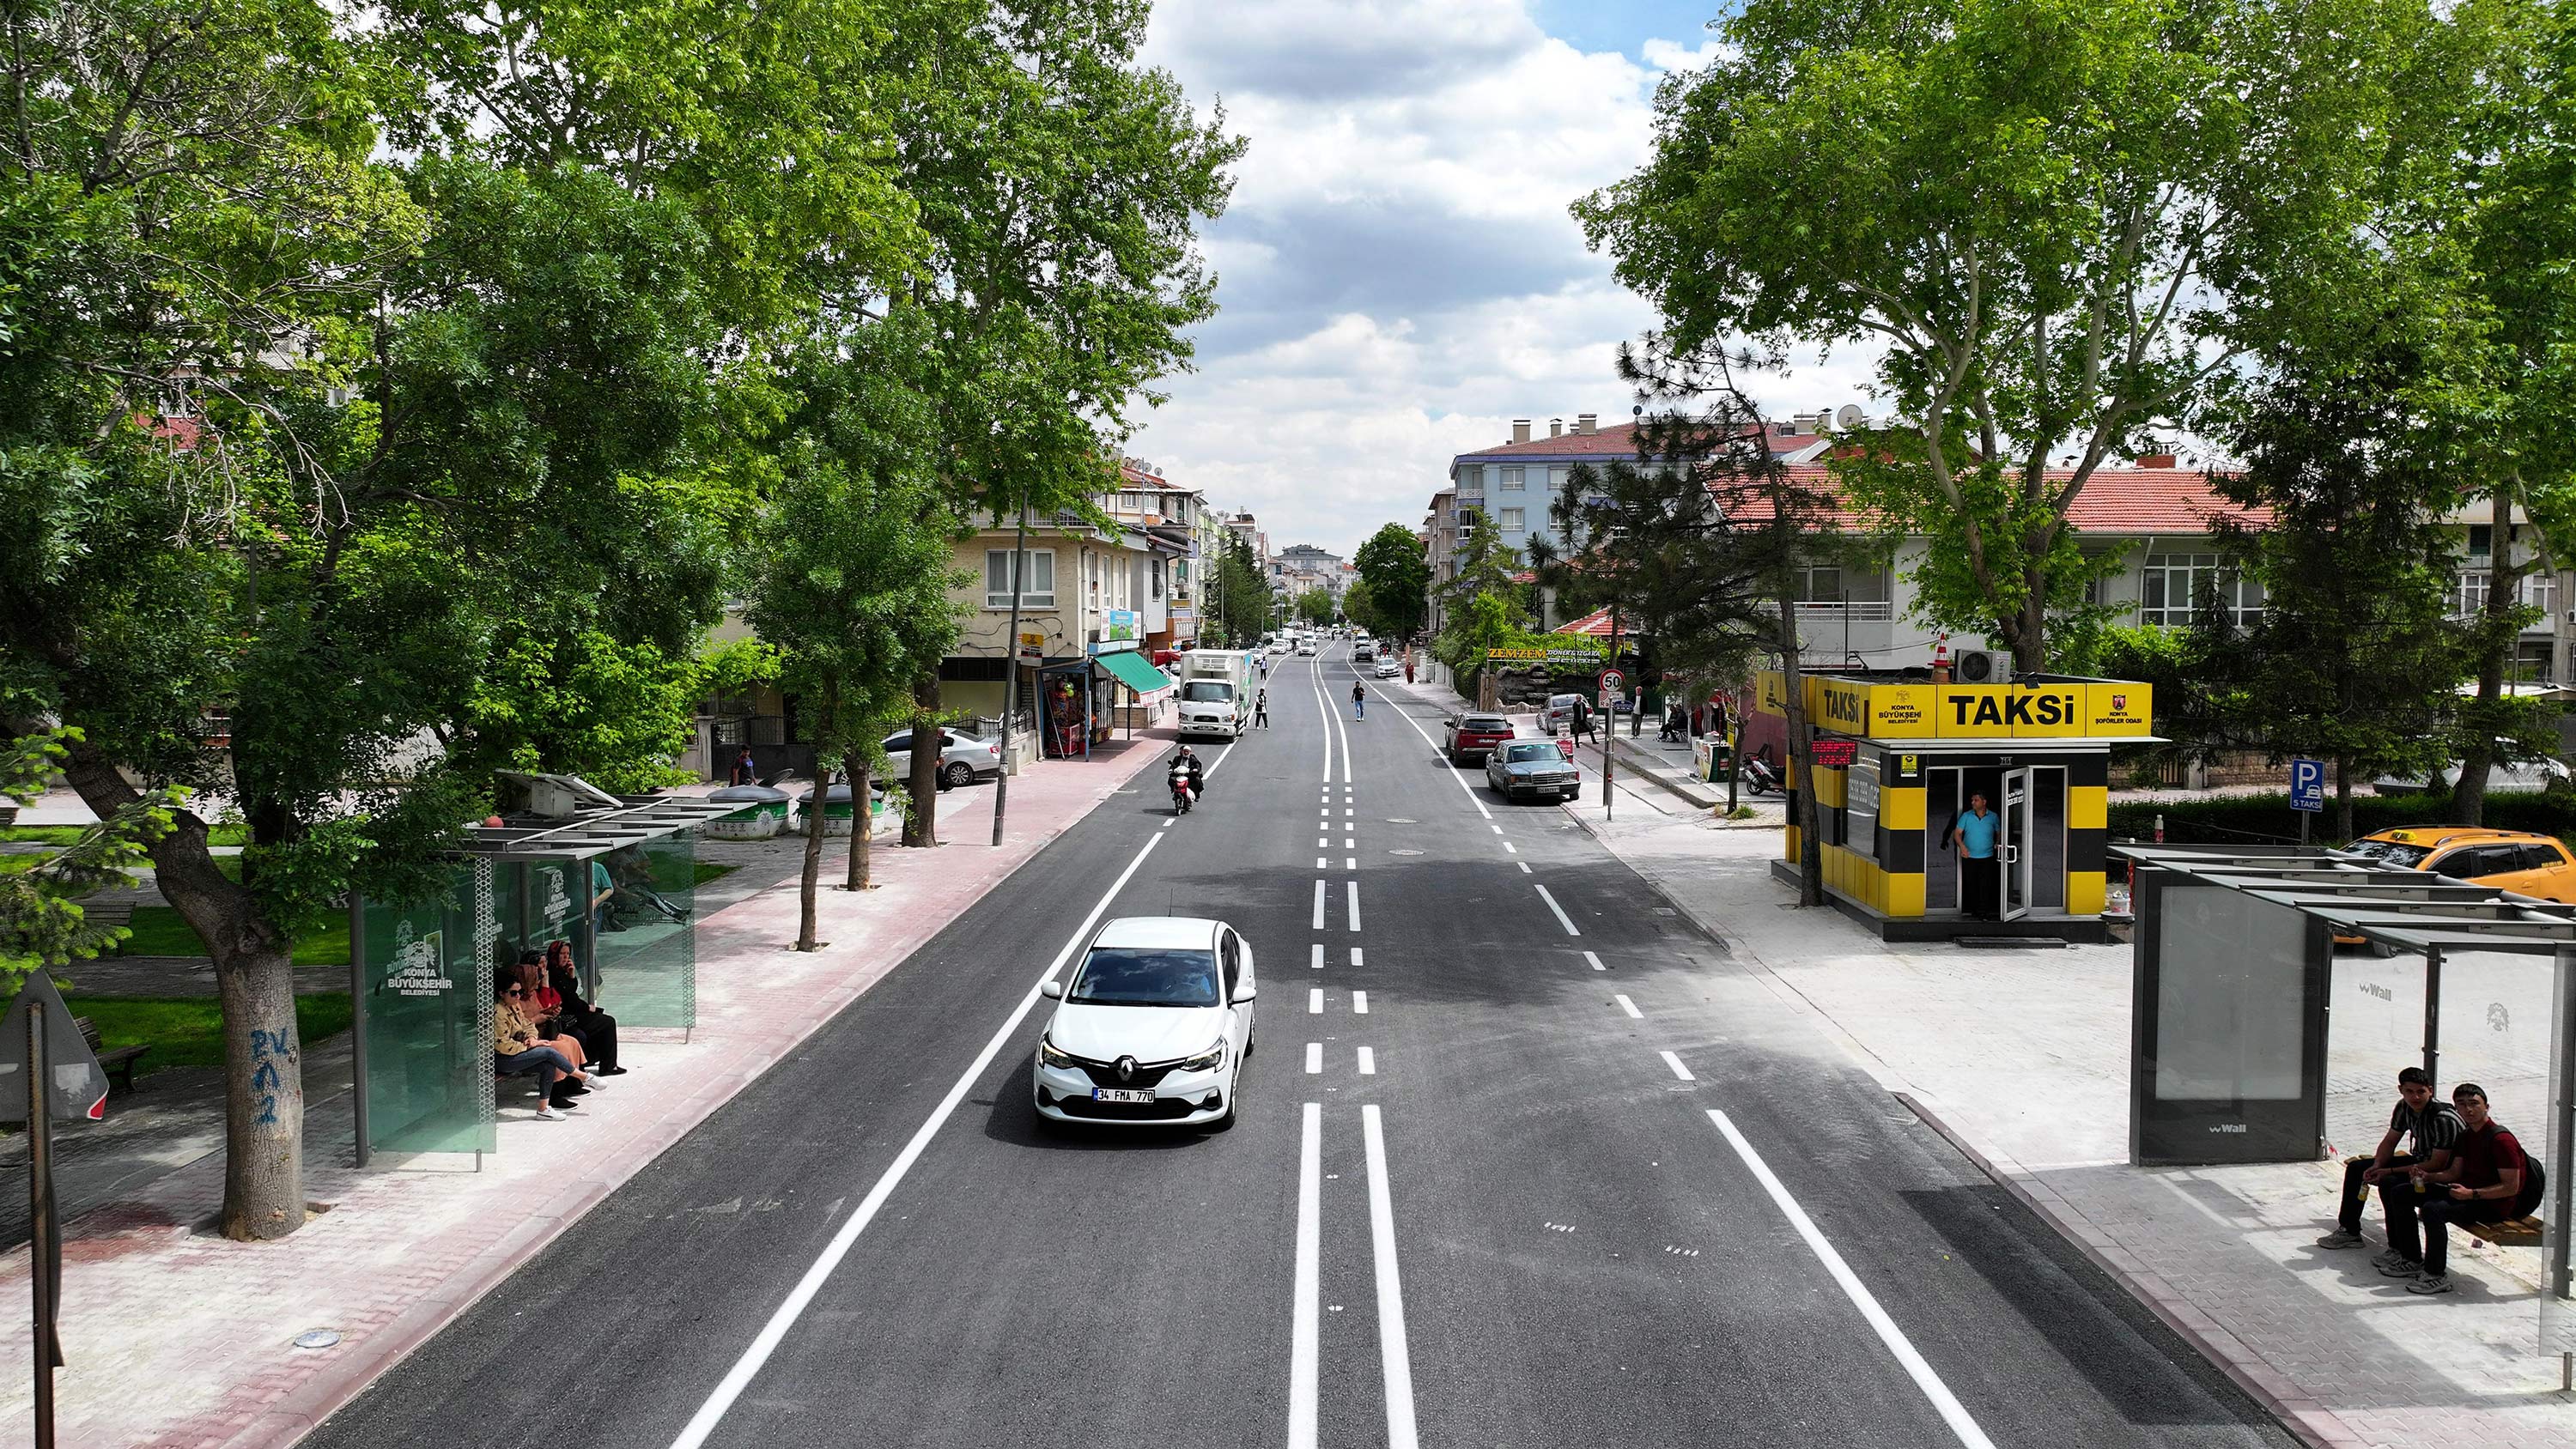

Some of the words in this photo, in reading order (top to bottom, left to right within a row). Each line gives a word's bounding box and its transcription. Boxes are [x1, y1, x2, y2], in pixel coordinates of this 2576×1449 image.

[1488, 647, 1546, 658] ZEMZEM
[1605, 676, 1620, 688] 50
[2095, 717, 2124, 725] ŞOFÖRLER
[2298, 763, 2318, 790] P
[404, 968, 436, 977] KONYA
[388, 977, 453, 990] BÜYÜKŞEHİR
[1099, 1089, 1109, 1100] 34
[1115, 1090, 1131, 1100] FMA
[1137, 1091, 1153, 1102] 770
[2221, 1124, 2246, 1133] Wall
